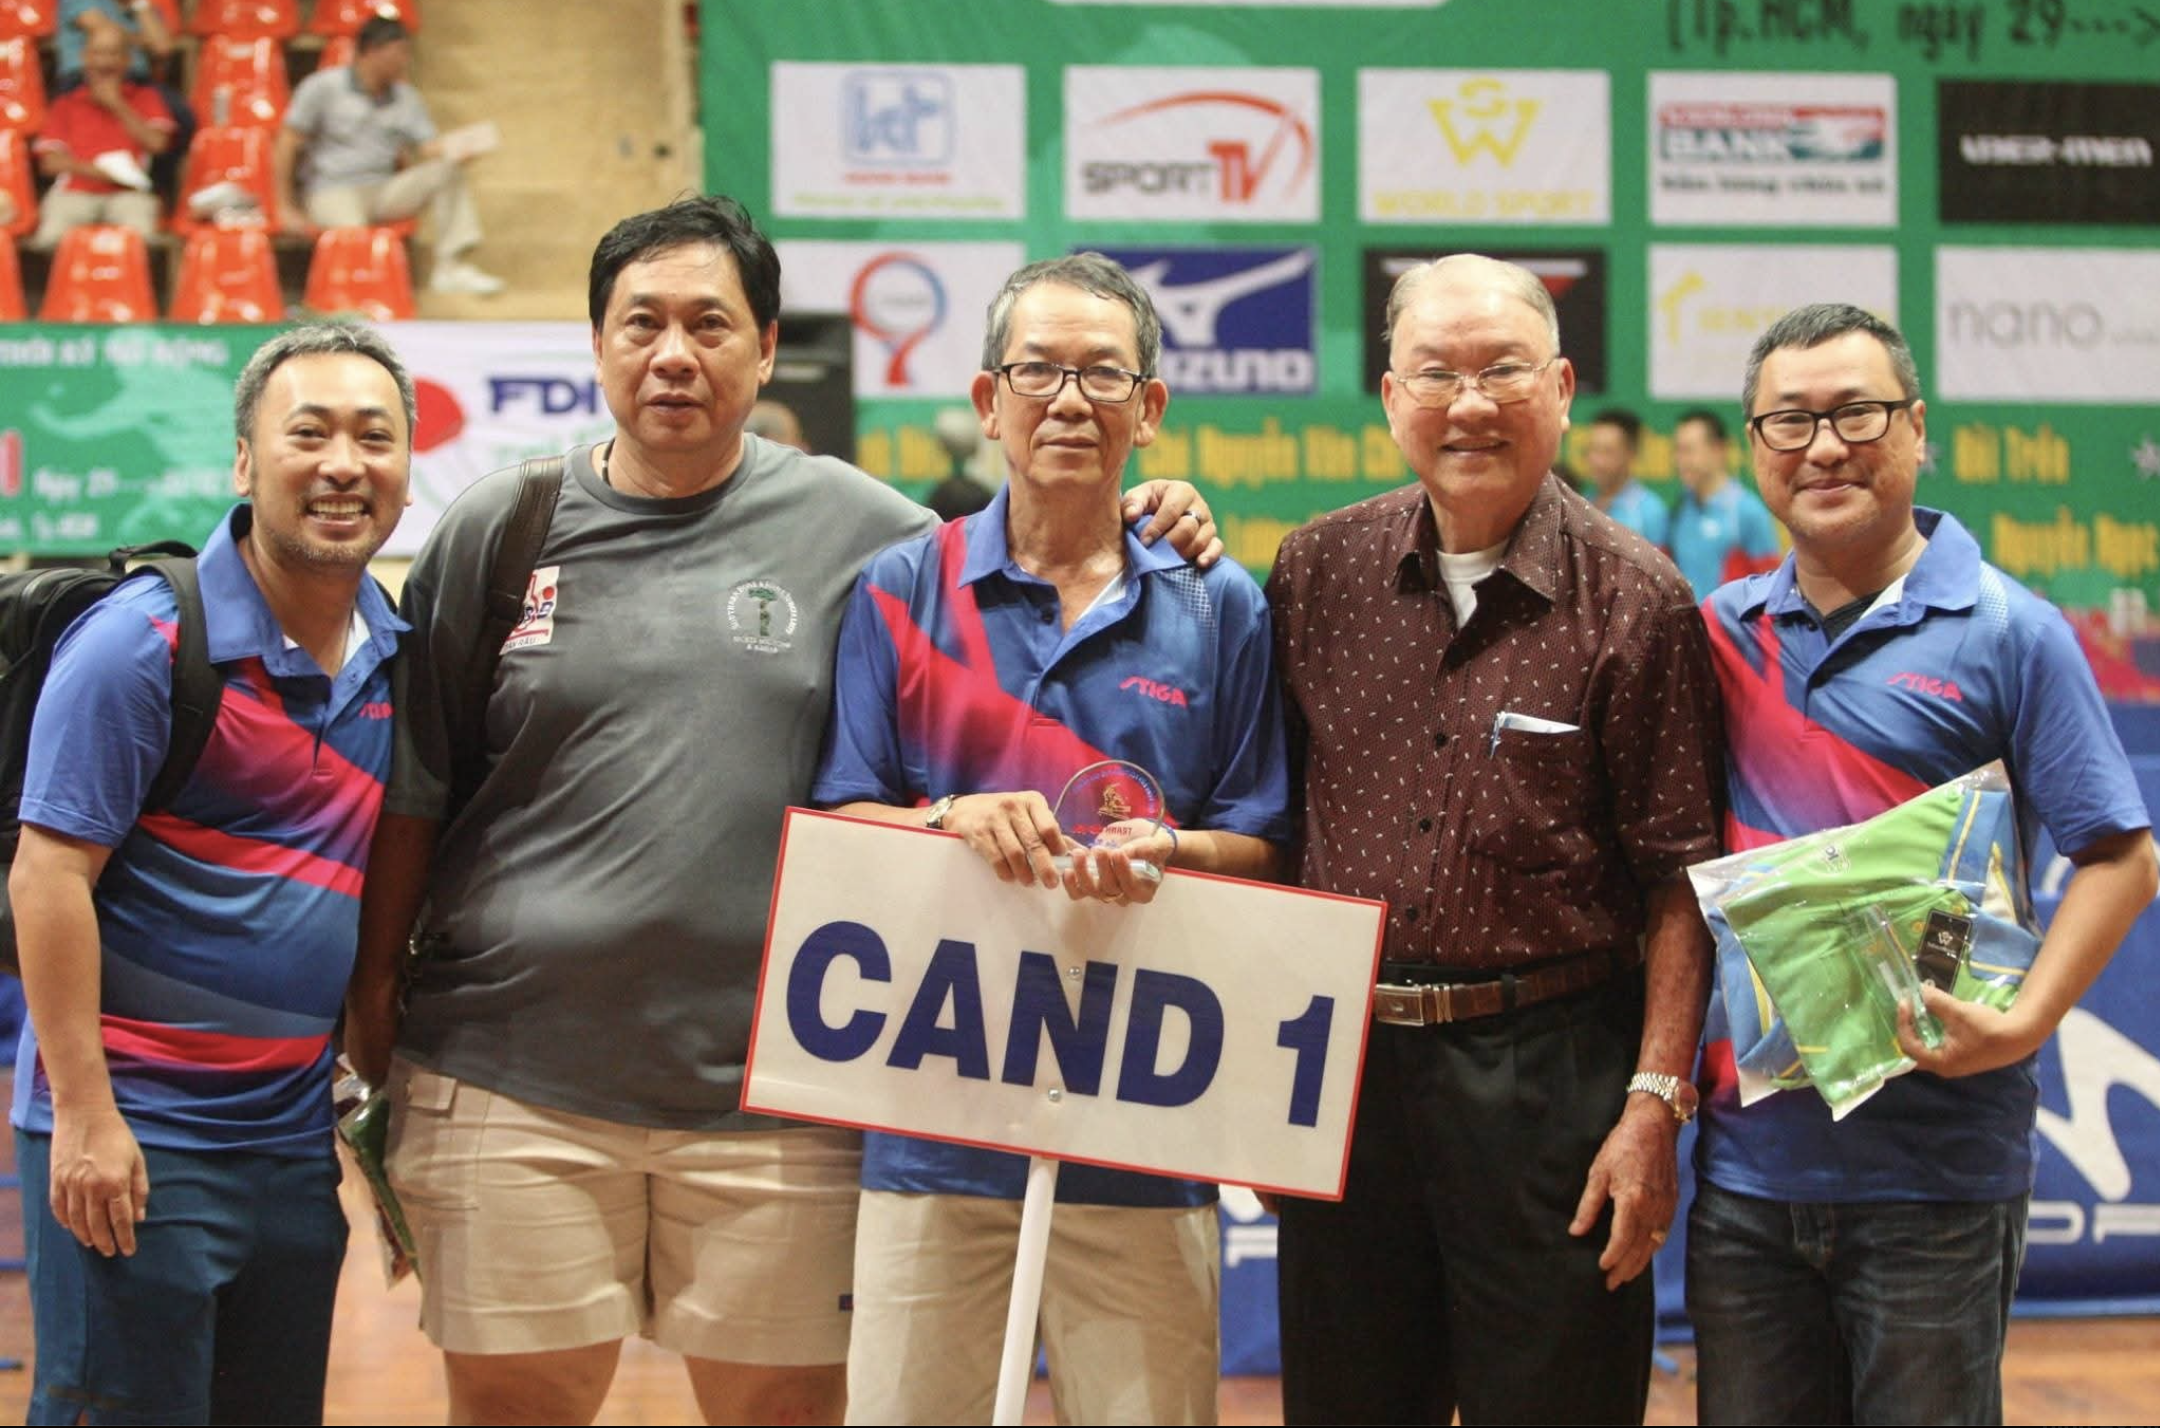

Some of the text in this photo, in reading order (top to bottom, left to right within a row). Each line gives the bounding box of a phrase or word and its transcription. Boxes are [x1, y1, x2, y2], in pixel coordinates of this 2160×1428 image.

[1948, 300, 2104, 349] nano
[1158, 349, 1315, 392] IZUNO
[1119, 675, 1188, 709] STIGA
[1886, 671, 1962, 702] STIGA
[787, 921, 1335, 1128] CAND 1
